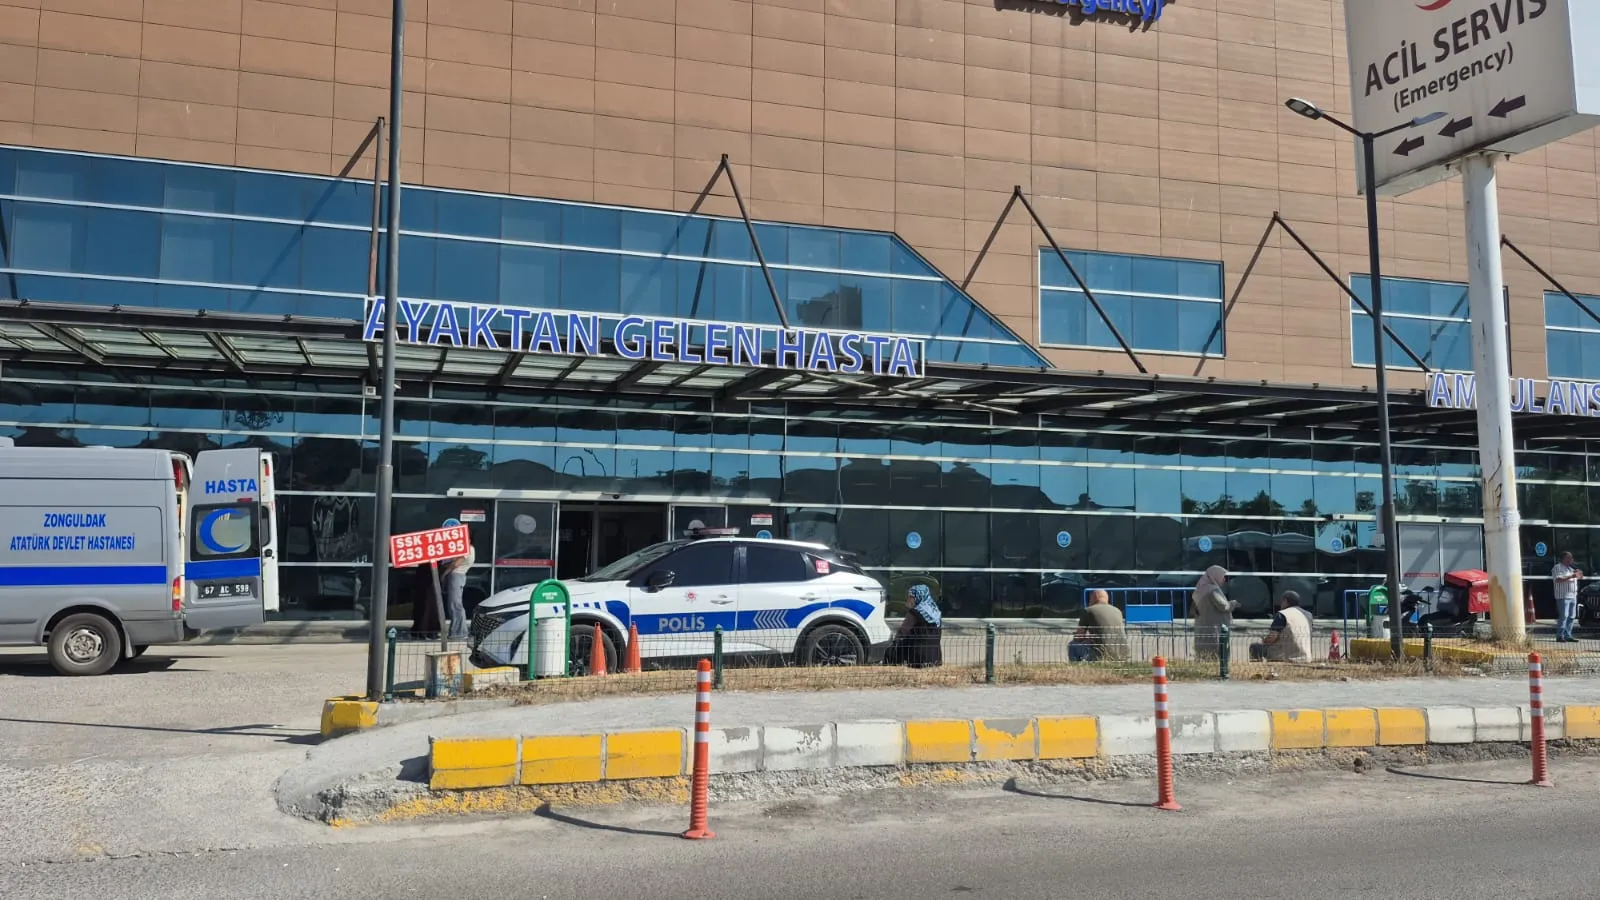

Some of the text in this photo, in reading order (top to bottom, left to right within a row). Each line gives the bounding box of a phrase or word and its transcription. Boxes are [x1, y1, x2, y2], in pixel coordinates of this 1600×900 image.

[1365, 40, 1427, 97] ACİL
[1393, 41, 1514, 113] (Emergency)
[362, 297, 918, 378] AYAKTAN GELEN HASTA
[1430, 372, 1600, 417] AMULANS
[205, 478, 257, 494] HASTA
[43, 513, 107, 528] ZONGULDAK
[9, 531, 136, 551] ATATÜRK DEVLET HASTANESİ
[396, 534, 423, 549] SSK
[397, 539, 465, 562] 253 83 95
[205, 586, 215, 595] 67
[658, 613, 706, 632] POLİS
